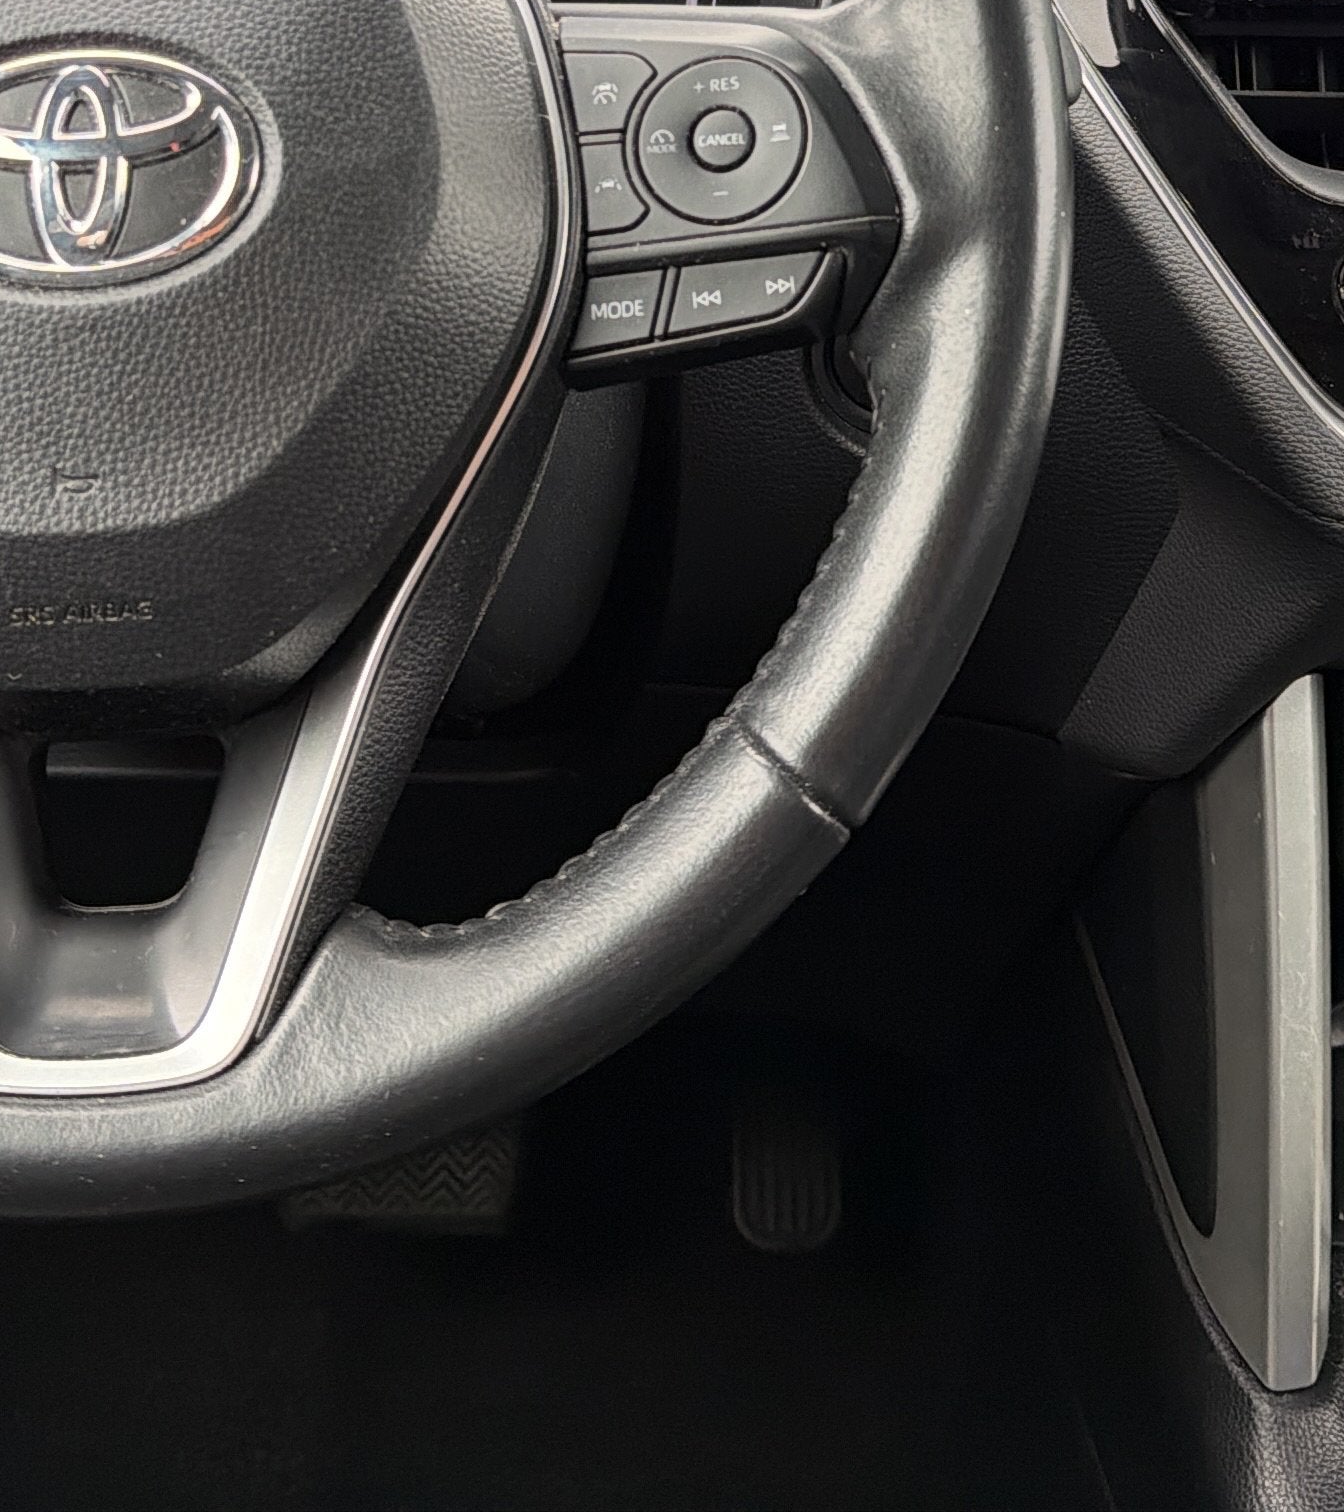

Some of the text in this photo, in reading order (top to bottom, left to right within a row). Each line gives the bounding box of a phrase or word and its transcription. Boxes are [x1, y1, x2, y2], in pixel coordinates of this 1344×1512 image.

[709, 76, 740, 91] RES
[697, 133, 746, 148] CANCEL
[590, 299, 645, 320] MODE
[8, 599, 154, 627] SRS AIRBAG
